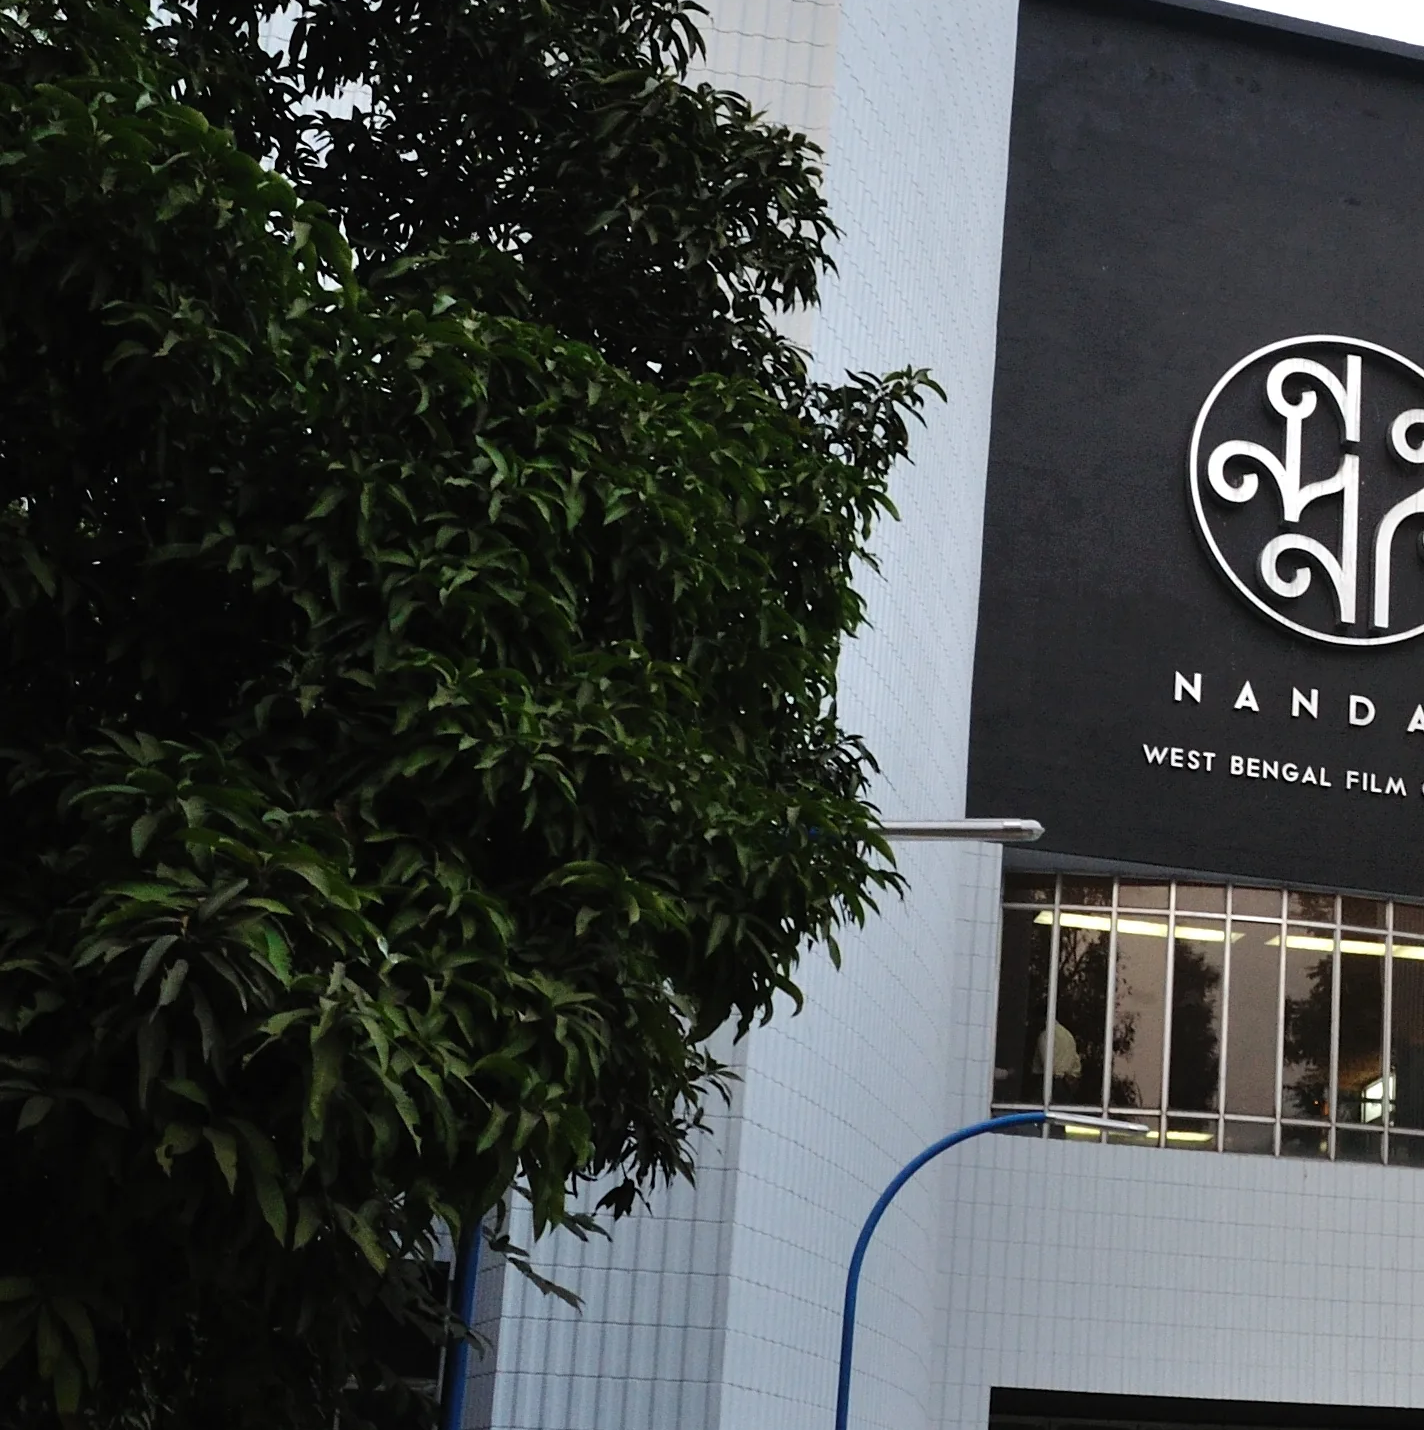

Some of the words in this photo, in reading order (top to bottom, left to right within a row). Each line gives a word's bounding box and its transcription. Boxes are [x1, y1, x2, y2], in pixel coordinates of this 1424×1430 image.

[1142, 743, 1217, 772] WEST
[1230, 754, 1332, 788] BENGAL
[1346, 769, 1407, 797] FILM
